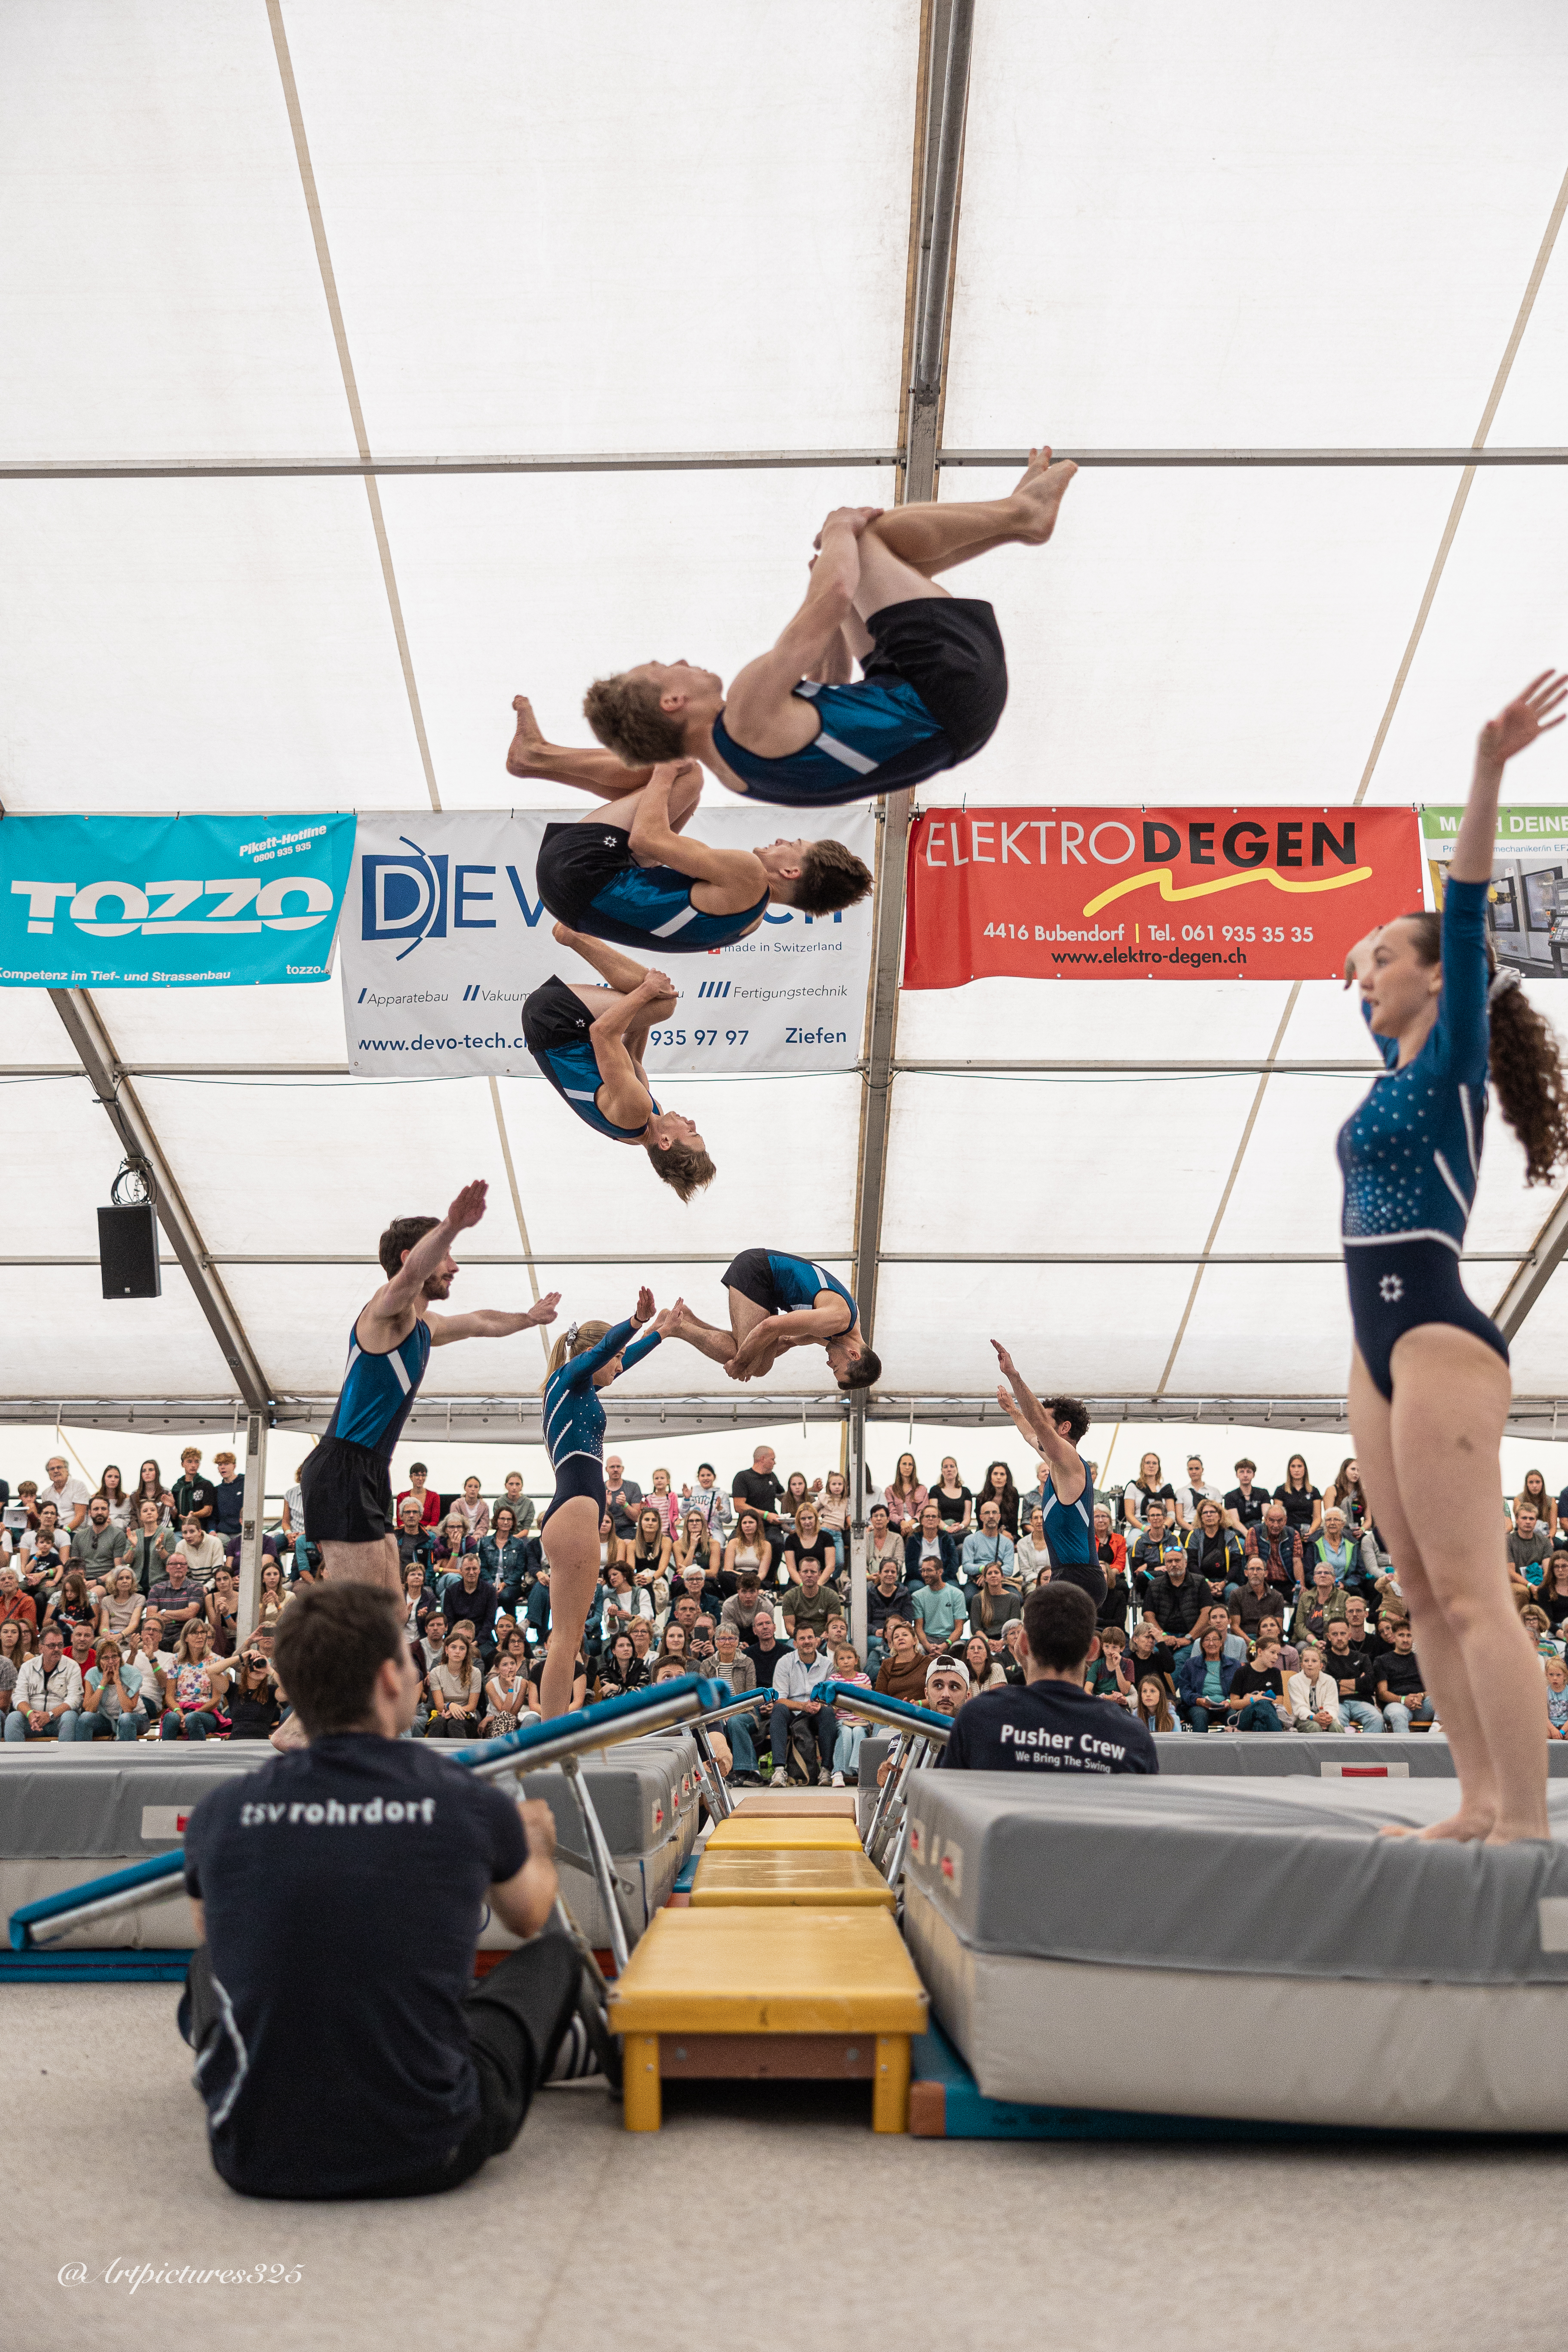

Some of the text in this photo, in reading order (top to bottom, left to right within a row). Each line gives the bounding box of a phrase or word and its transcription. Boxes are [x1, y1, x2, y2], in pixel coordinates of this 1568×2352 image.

[239, 825, 327, 856] Pikett-Hotline
[253, 842, 311, 863] 0800 935 935
[11, 877, 334, 937] TOZZO
[983, 922, 1314, 943] 4416 Bubendorf Tel. 061 935 35 35
[725, 942, 842, 952] made in Switzerland
[1051, 946, 1246, 968] www.elektro-degen.ch
[71, 971, 87, 980] im
[91, 971, 120, 980] Tief-
[124, 972, 149, 981] und
[151, 971, 231, 982] Strassenbau
[367, 991, 448, 1007] Apparatebau
[482, 990, 530, 1001] Vakuum
[734, 985, 848, 1001] Fertigungstechnik
[650, 1027, 846, 1046] 935 97 97 Ziefen
[1000, 1724, 1126, 1761] Pusher Crew
[1015, 1750, 1111, 1773] We Bring The Swing
